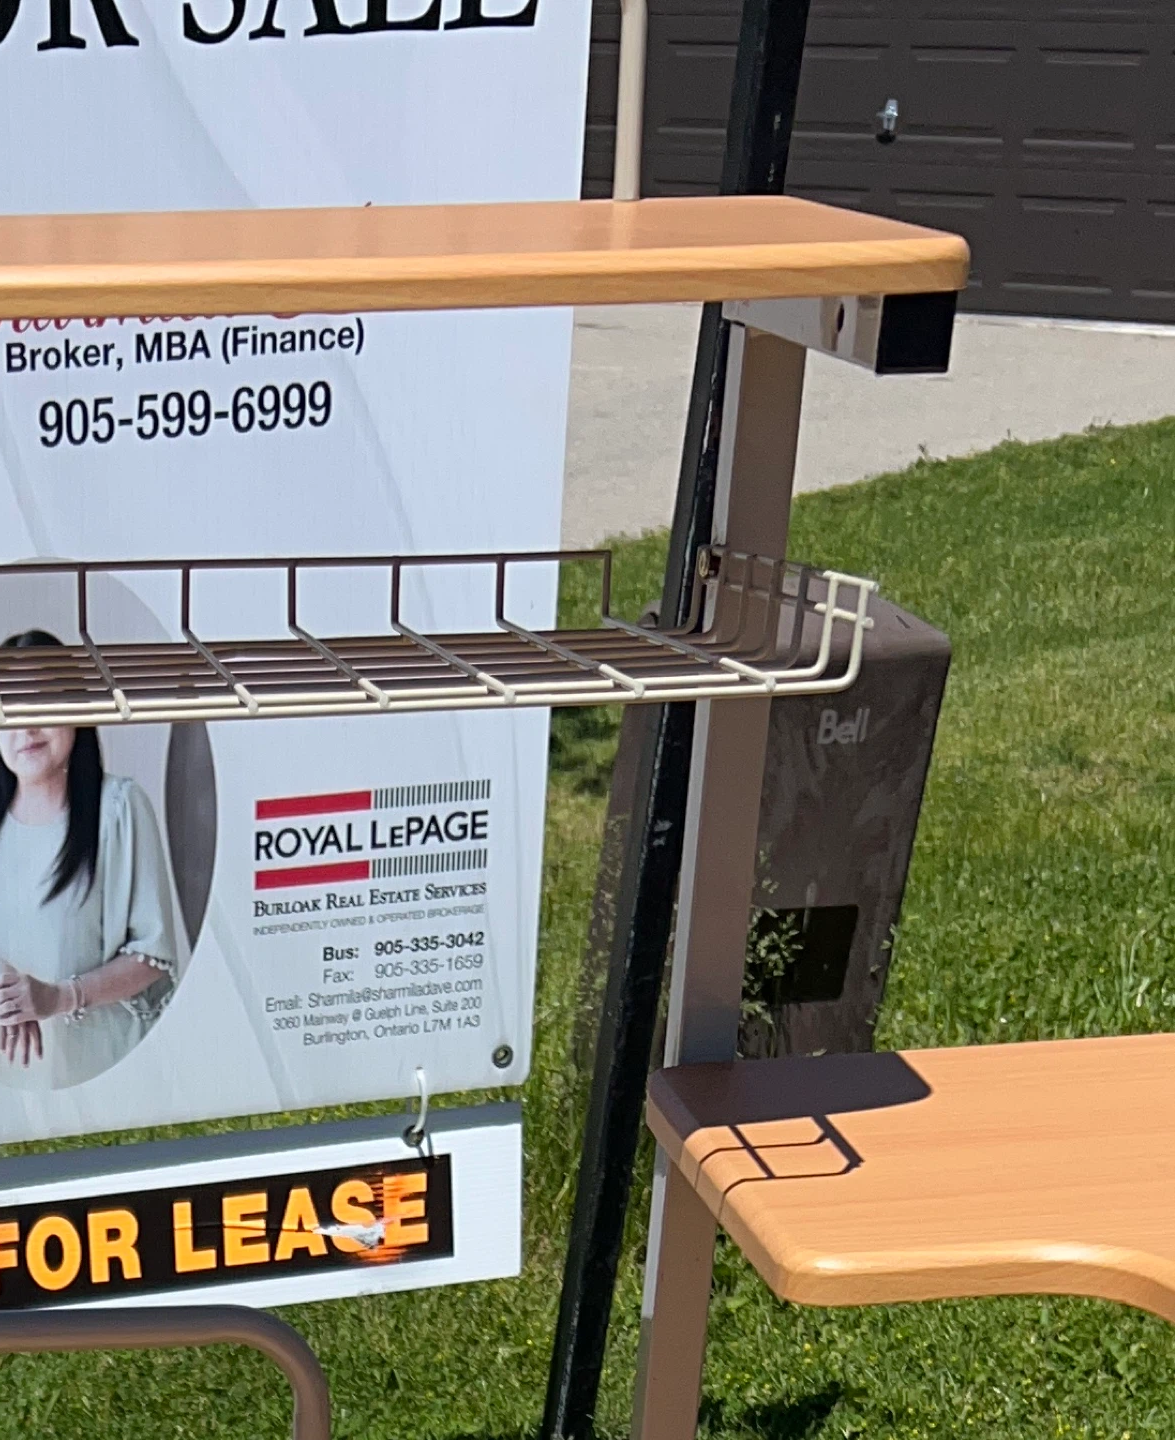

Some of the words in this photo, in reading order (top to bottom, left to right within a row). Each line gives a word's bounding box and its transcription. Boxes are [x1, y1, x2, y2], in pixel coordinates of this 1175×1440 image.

[5, 339, 124, 374] Broker,
[135, 329, 211, 364] MBA
[221, 318, 366, 364] (Finance)
[39, 380, 332, 448] 905-599-6999
[816, 707, 871, 745] Bell
[254, 822, 364, 861] ROYAL
[322, 946, 359, 962] Bus:
[374, 931, 485, 956] 905-335-3042
[323, 968, 355, 984] Fax:
[374, 953, 484, 979] 905-335-1659
[265, 994, 302, 1013] Email:
[375, 1020, 420, 1039] Ontario
[173, 1172, 430, 1274] LEASE
